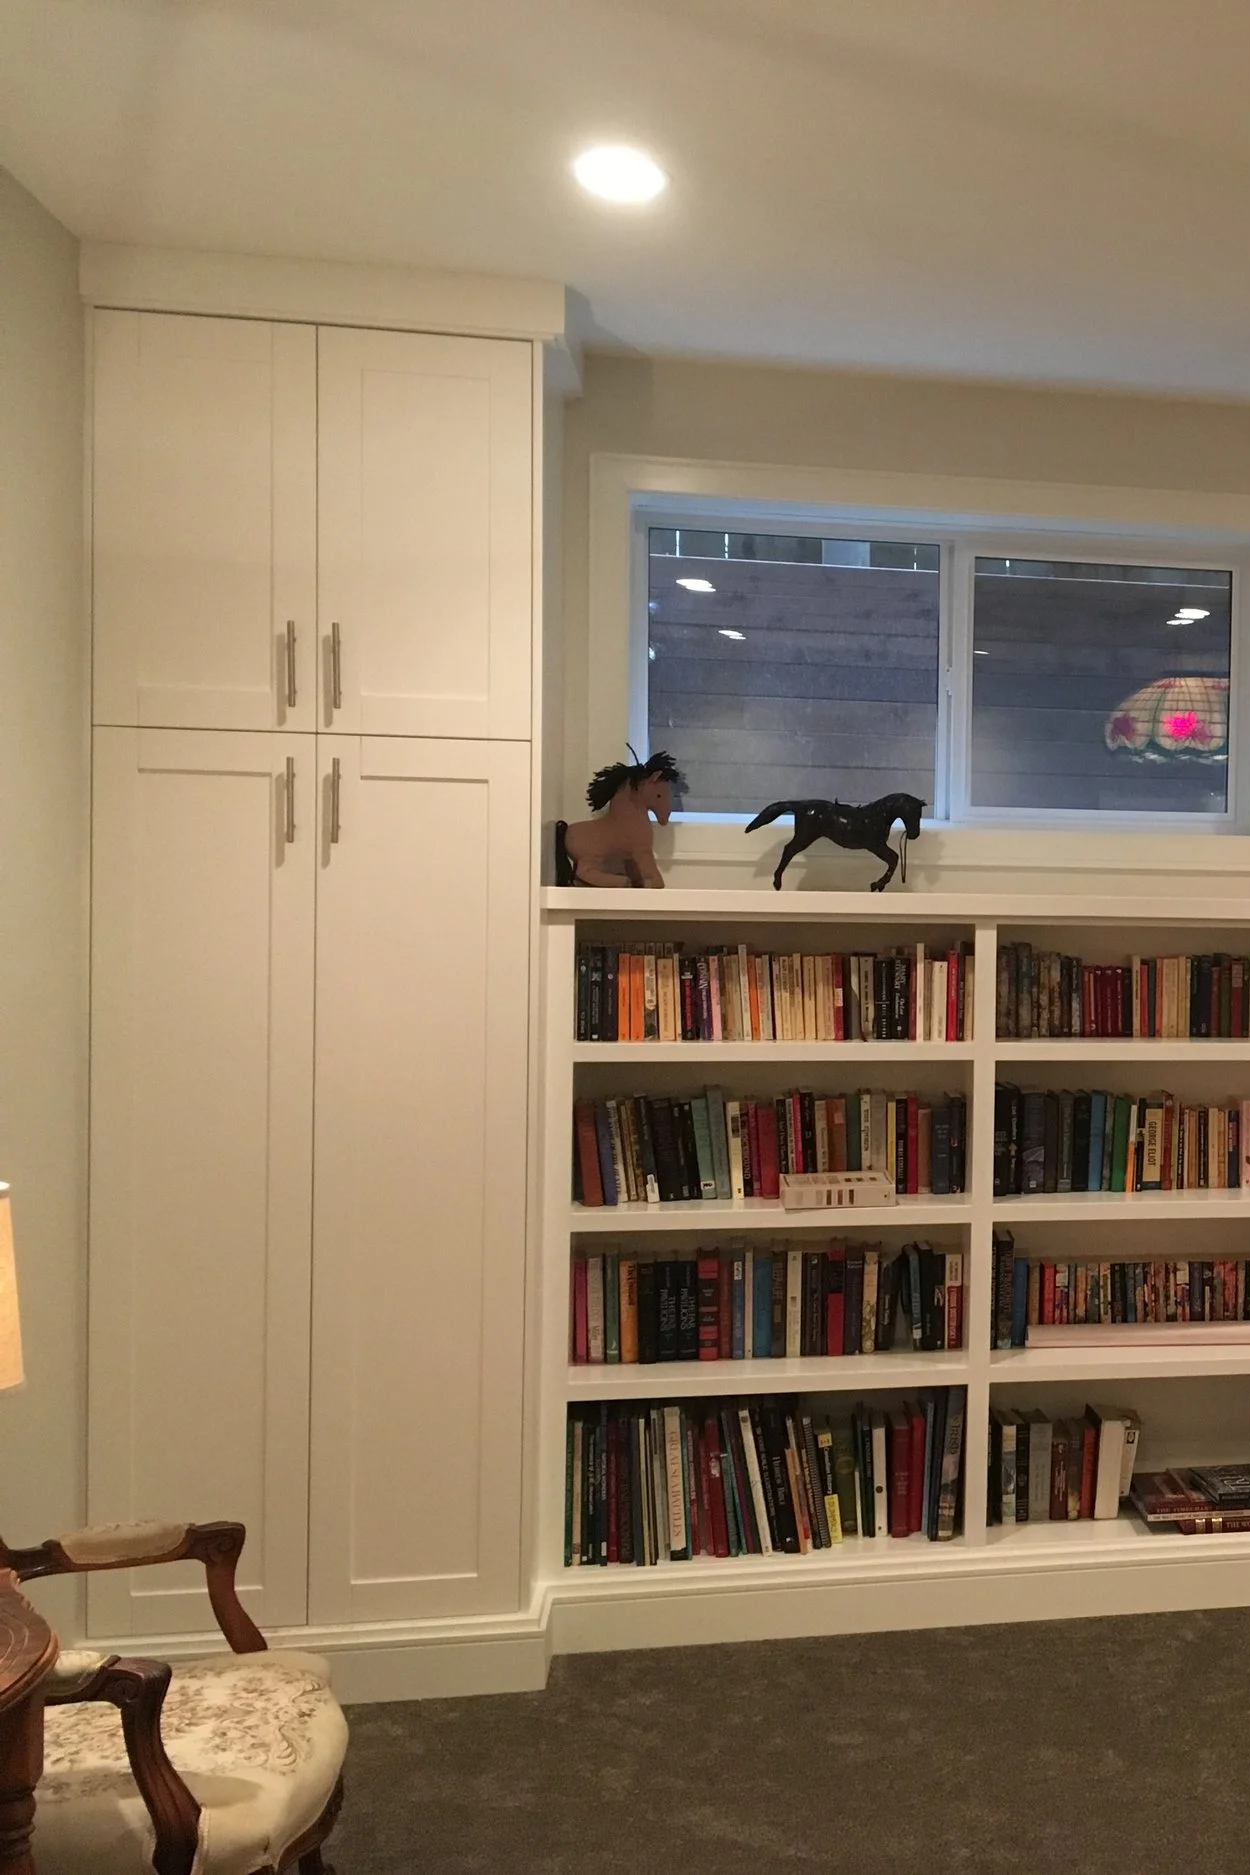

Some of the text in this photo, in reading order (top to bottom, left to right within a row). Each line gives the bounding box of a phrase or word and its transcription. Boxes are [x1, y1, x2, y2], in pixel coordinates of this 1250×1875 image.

[1147, 1121, 1157, 1167] GEORGE ELIOT
[669, 1431, 682, 1537] GREAT SEA BATTLES
[1226, 1521, 1240, 1529] THE
